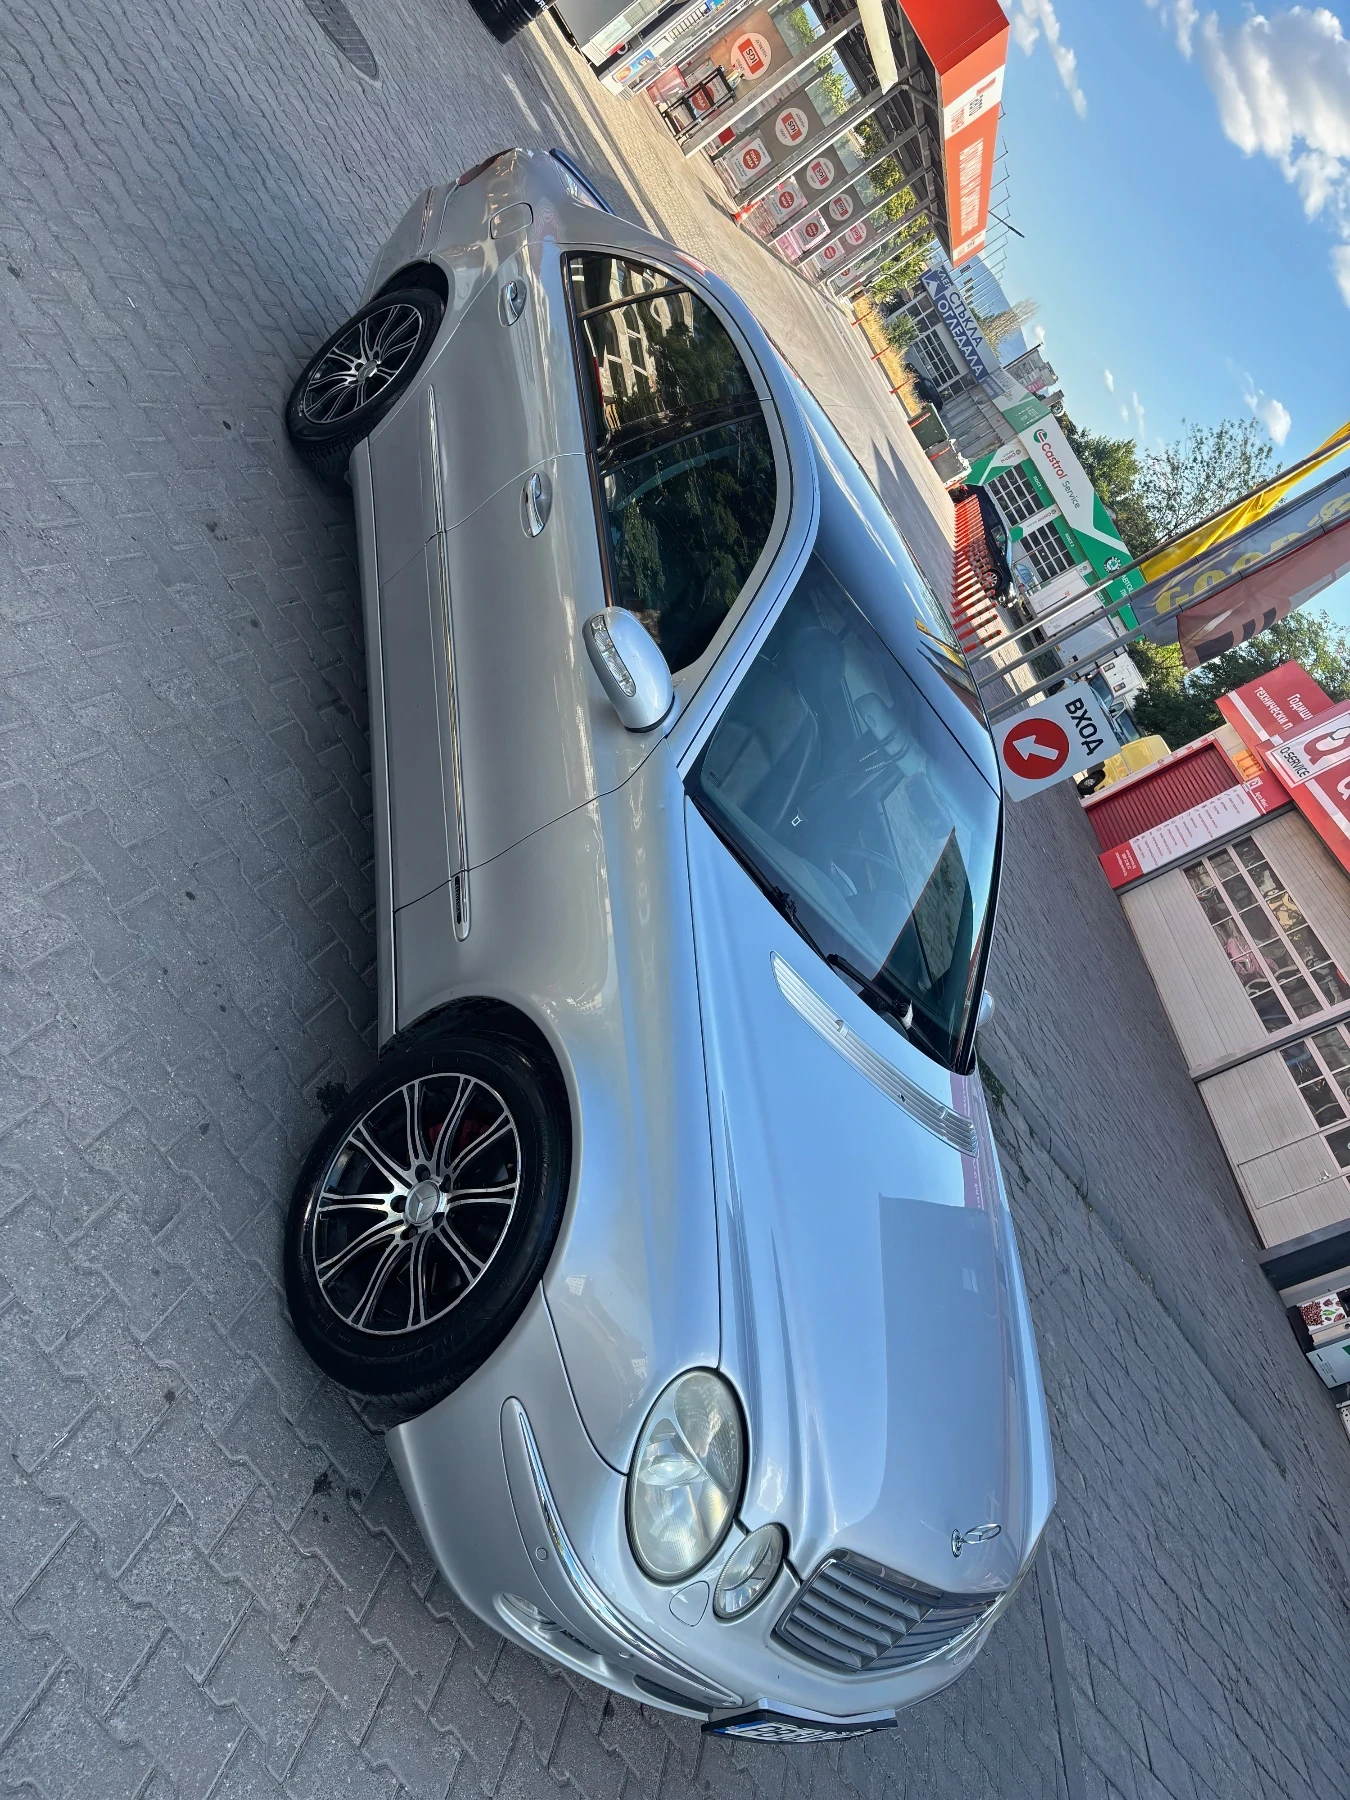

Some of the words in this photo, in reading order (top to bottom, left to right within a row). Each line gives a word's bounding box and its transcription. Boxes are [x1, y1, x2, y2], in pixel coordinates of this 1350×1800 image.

[745, 47, 758, 64] SDI
[786, 119, 797, 133] SDI
[934, 266, 952, 290] КЛЕР
[934, 297, 985, 377] ОГЛЕДАЛА
[945, 289, 984, 348] СТЪКЛА
[1039, 440, 1068, 481] Castrol
[1060, 479, 1082, 509] Service
[1064, 697, 1104, 756] ВХОД
[1253, 685, 1288, 724] технически
